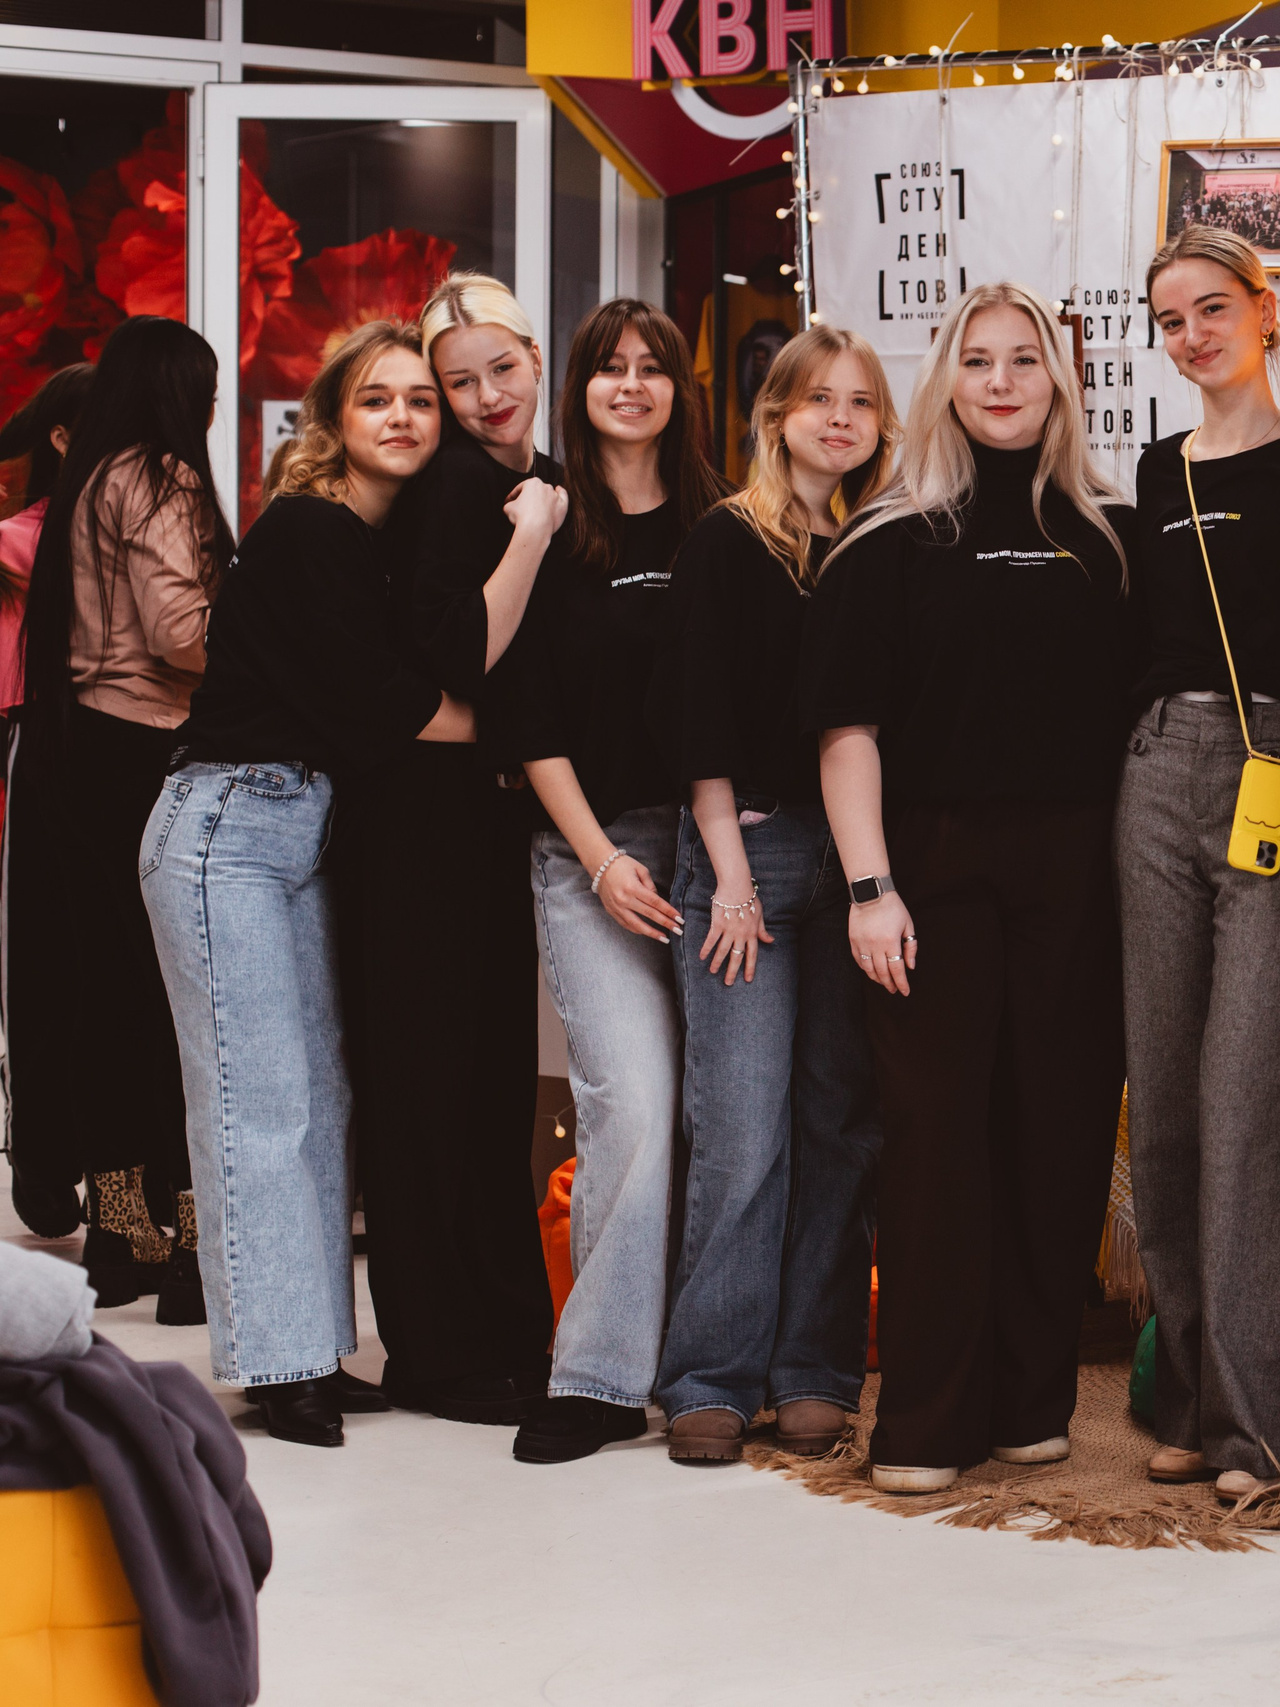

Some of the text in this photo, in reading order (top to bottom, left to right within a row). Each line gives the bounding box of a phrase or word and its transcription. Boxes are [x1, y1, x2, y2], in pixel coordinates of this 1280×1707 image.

[632, 0, 833, 80] КВН
[900, 162, 942, 178] СОЮЗ
[900, 187, 944, 212] СТУ
[898, 233, 946, 261] ДЕН
[899, 280, 946, 304] ТОВ
[1084, 289, 1131, 306] СОЮЗ
[1084, 315, 1132, 340] СТУ
[1083, 362, 1133, 390] ДЕН
[1085, 409, 1133, 434] ТОВ
